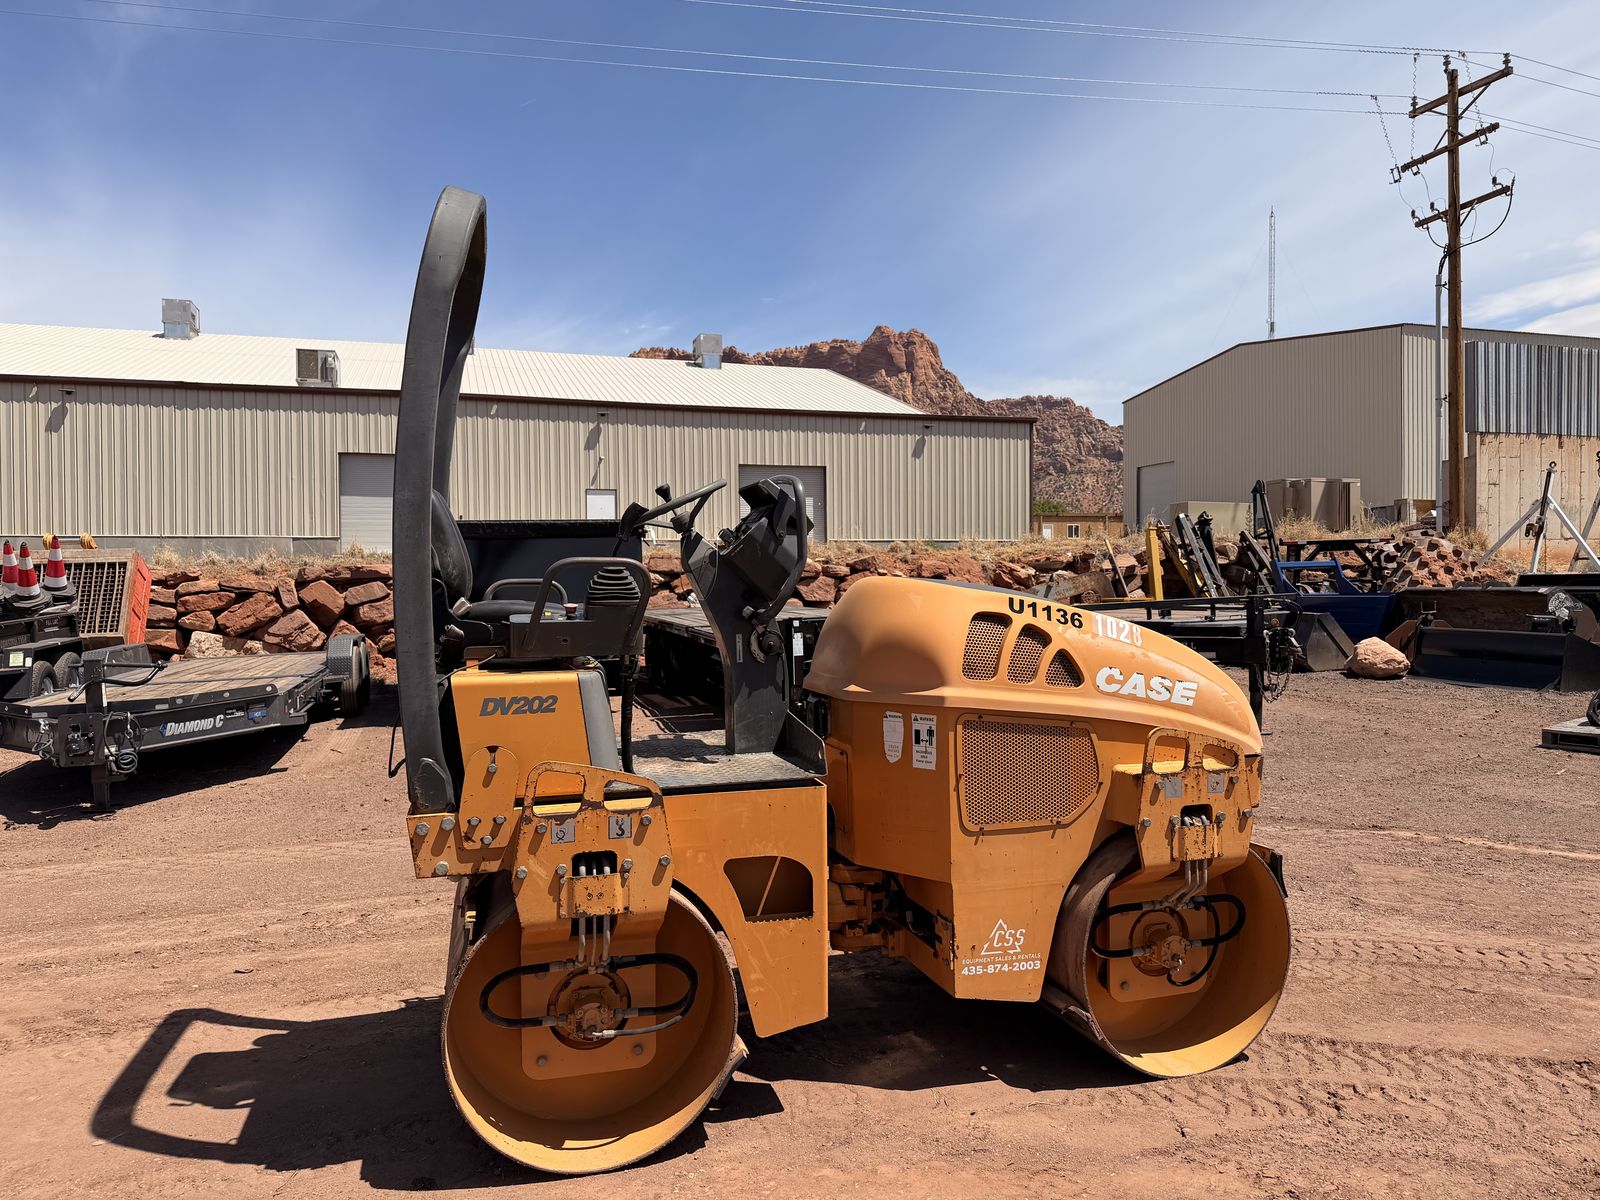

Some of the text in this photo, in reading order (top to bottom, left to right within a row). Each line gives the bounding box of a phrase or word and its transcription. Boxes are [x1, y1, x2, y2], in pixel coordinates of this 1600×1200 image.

[1008, 597, 1084, 629] U1136
[1095, 614, 1142, 646] 1028
[1095, 666, 1198, 706] CASE
[480, 695, 559, 716] DV202
[165, 714, 224, 736] DIAMOND C
[993, 929, 1025, 947] CSS
[961, 960, 1041, 976] 435-874-2003
[962, 957, 993, 965] EQUIPMENT
